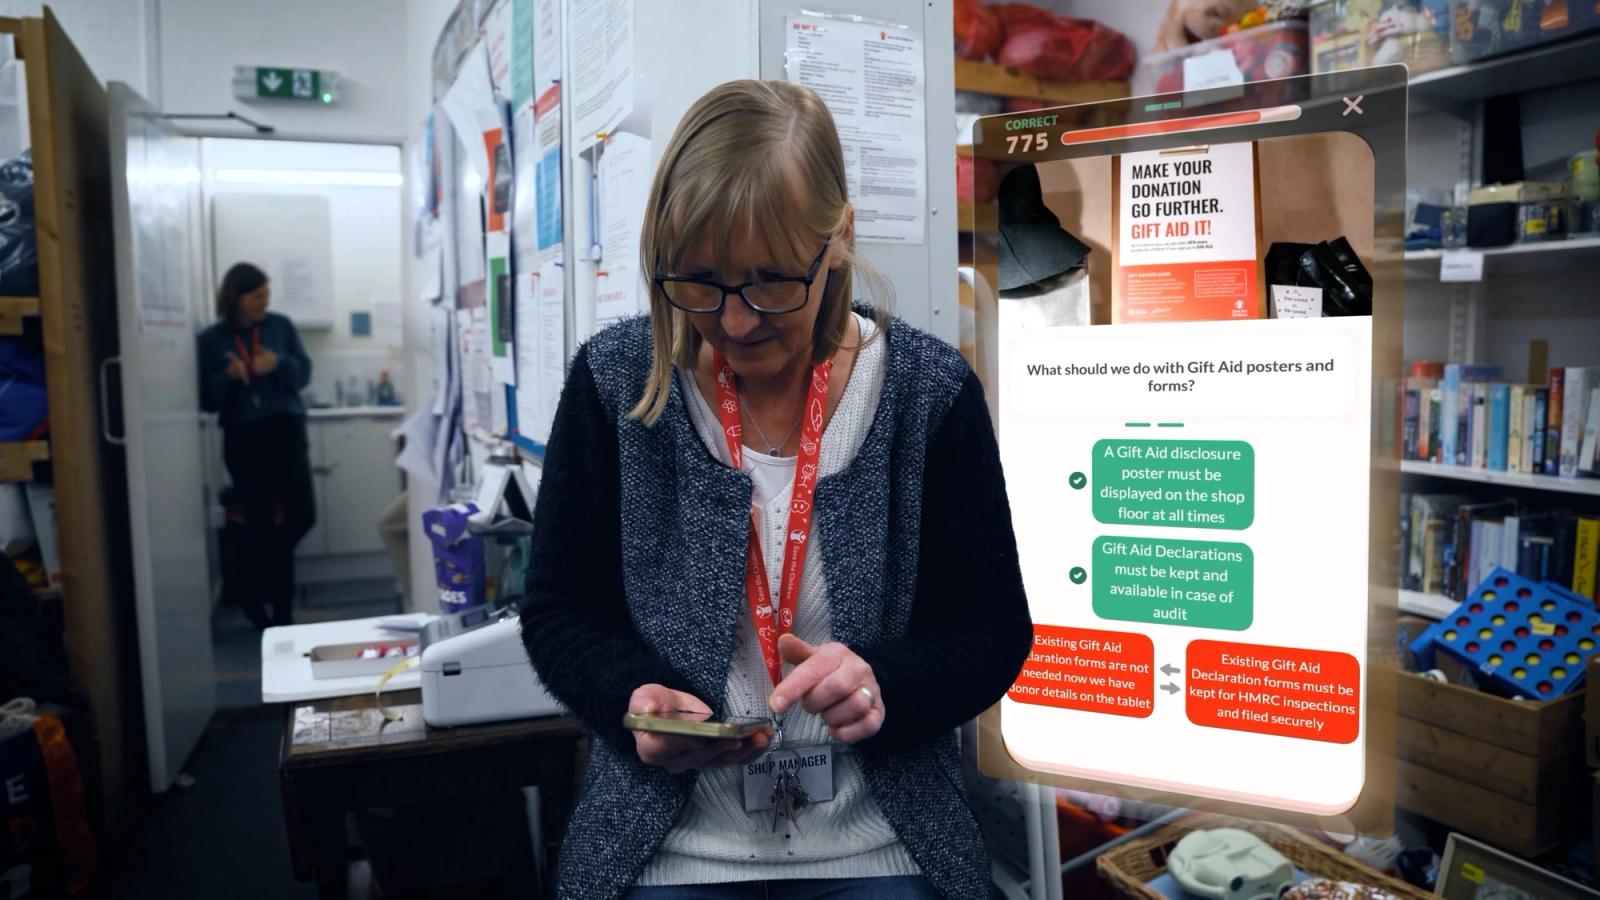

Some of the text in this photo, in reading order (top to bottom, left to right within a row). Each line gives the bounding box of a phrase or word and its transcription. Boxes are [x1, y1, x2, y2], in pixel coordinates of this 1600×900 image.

[1132, 159, 1212, 180] MAKE YOUR
[1132, 180, 1201, 199] DONATION
[1131, 198, 1223, 218] GO FURTHER.
[1131, 219, 1211, 239] GIFT AID IT!
[791, 545, 800, 560] Save
[758, 586, 766, 602] Save
[786, 573, 796, 600] Children
[748, 754, 827, 775] SHOP MANAGER
